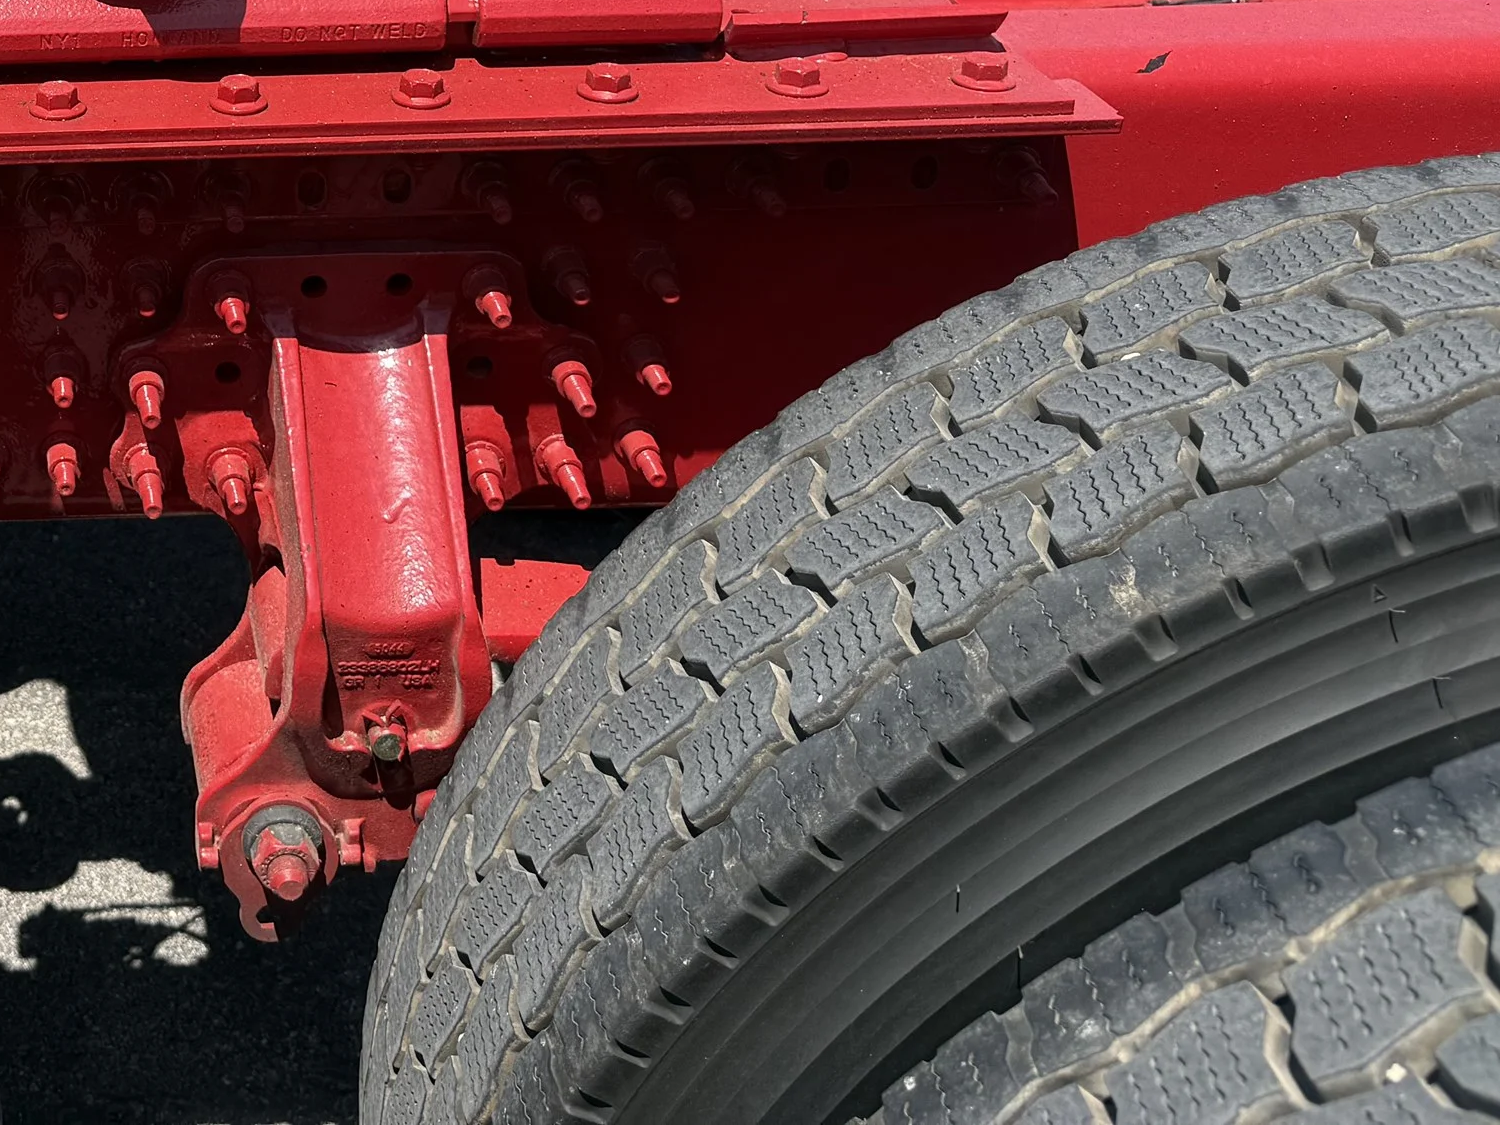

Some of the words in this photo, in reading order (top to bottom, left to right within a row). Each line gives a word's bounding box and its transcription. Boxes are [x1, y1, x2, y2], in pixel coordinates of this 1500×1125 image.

[282, 26, 306, 42] DO
[320, 24, 361, 41] NOT
[374, 22, 427, 39] WELD
